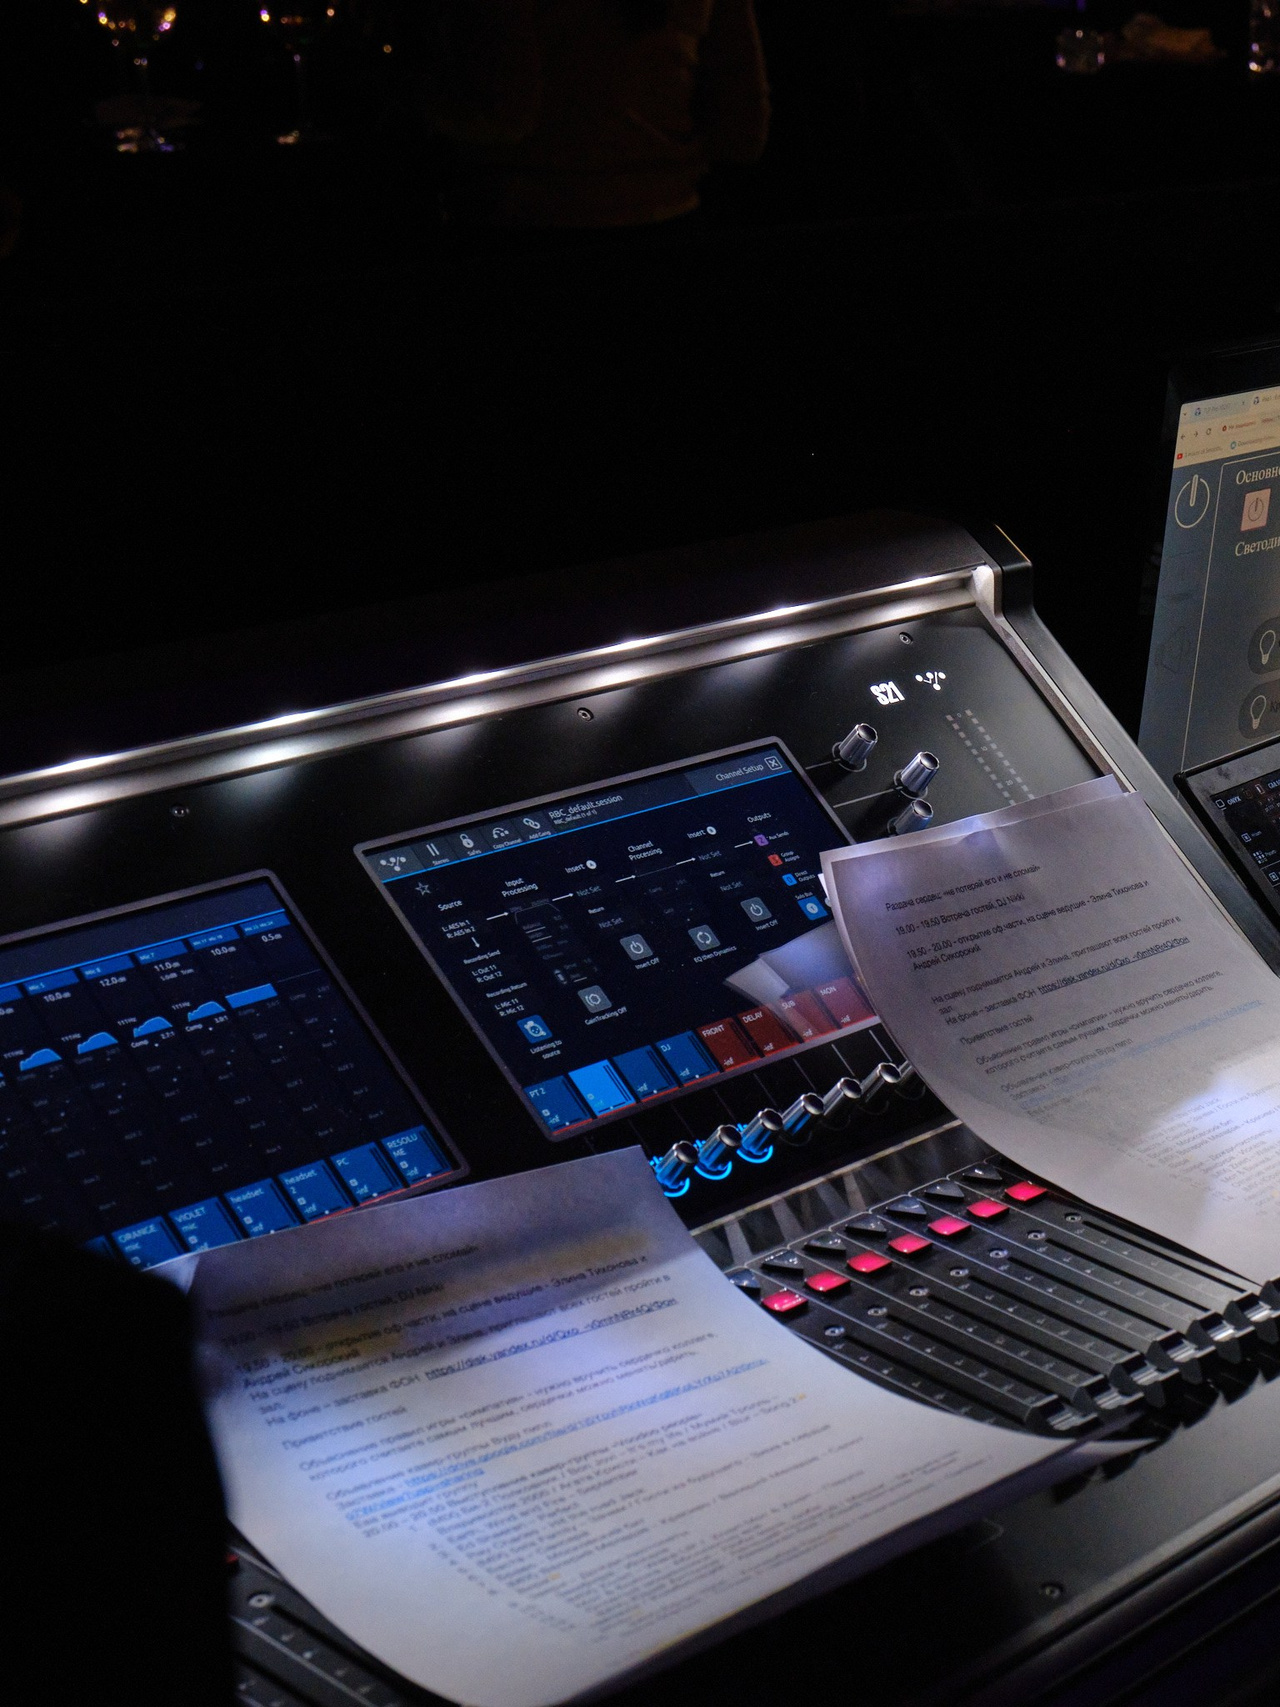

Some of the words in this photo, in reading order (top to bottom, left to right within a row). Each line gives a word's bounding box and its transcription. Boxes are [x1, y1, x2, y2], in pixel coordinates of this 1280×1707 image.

[870, 681, 905, 706] S21
[715, 768, 744, 781] Channel
[742, 764, 764, 774] Setup
[746, 812, 772, 823] Outputs
[686, 829, 706, 839] Insert
[627, 840, 654, 852] Channel
[628, 847, 663, 861] Processing
[564, 863, 585, 873] Insert
[504, 877, 524, 887] Input
[1110, 881, 1144, 895] Тихонова
[501, 883, 539, 897] Processing
[437, 900, 463, 911] Source
[939, 909, 971, 924] Встреча
[995, 897, 1008, 906] DJ
[912, 955, 941, 971] Андрей
[819, 986, 837, 996] MON
[781, 1000, 796, 1009] SUB
[741, 1011, 763, 1023] DELAY
[701, 1024, 724, 1037] FRONT
[660, 1043, 671, 1052] DJ
[528, 1089, 540, 1098] PT
[386, 1133, 418, 1149] RESOLU
[336, 1157, 349, 1167] PC
[283, 1169, 317, 1185] headset
[229, 1187, 264, 1203] headset
[289, 1186, 297, 1194] 2
[174, 1206, 205, 1223] VIOLET
